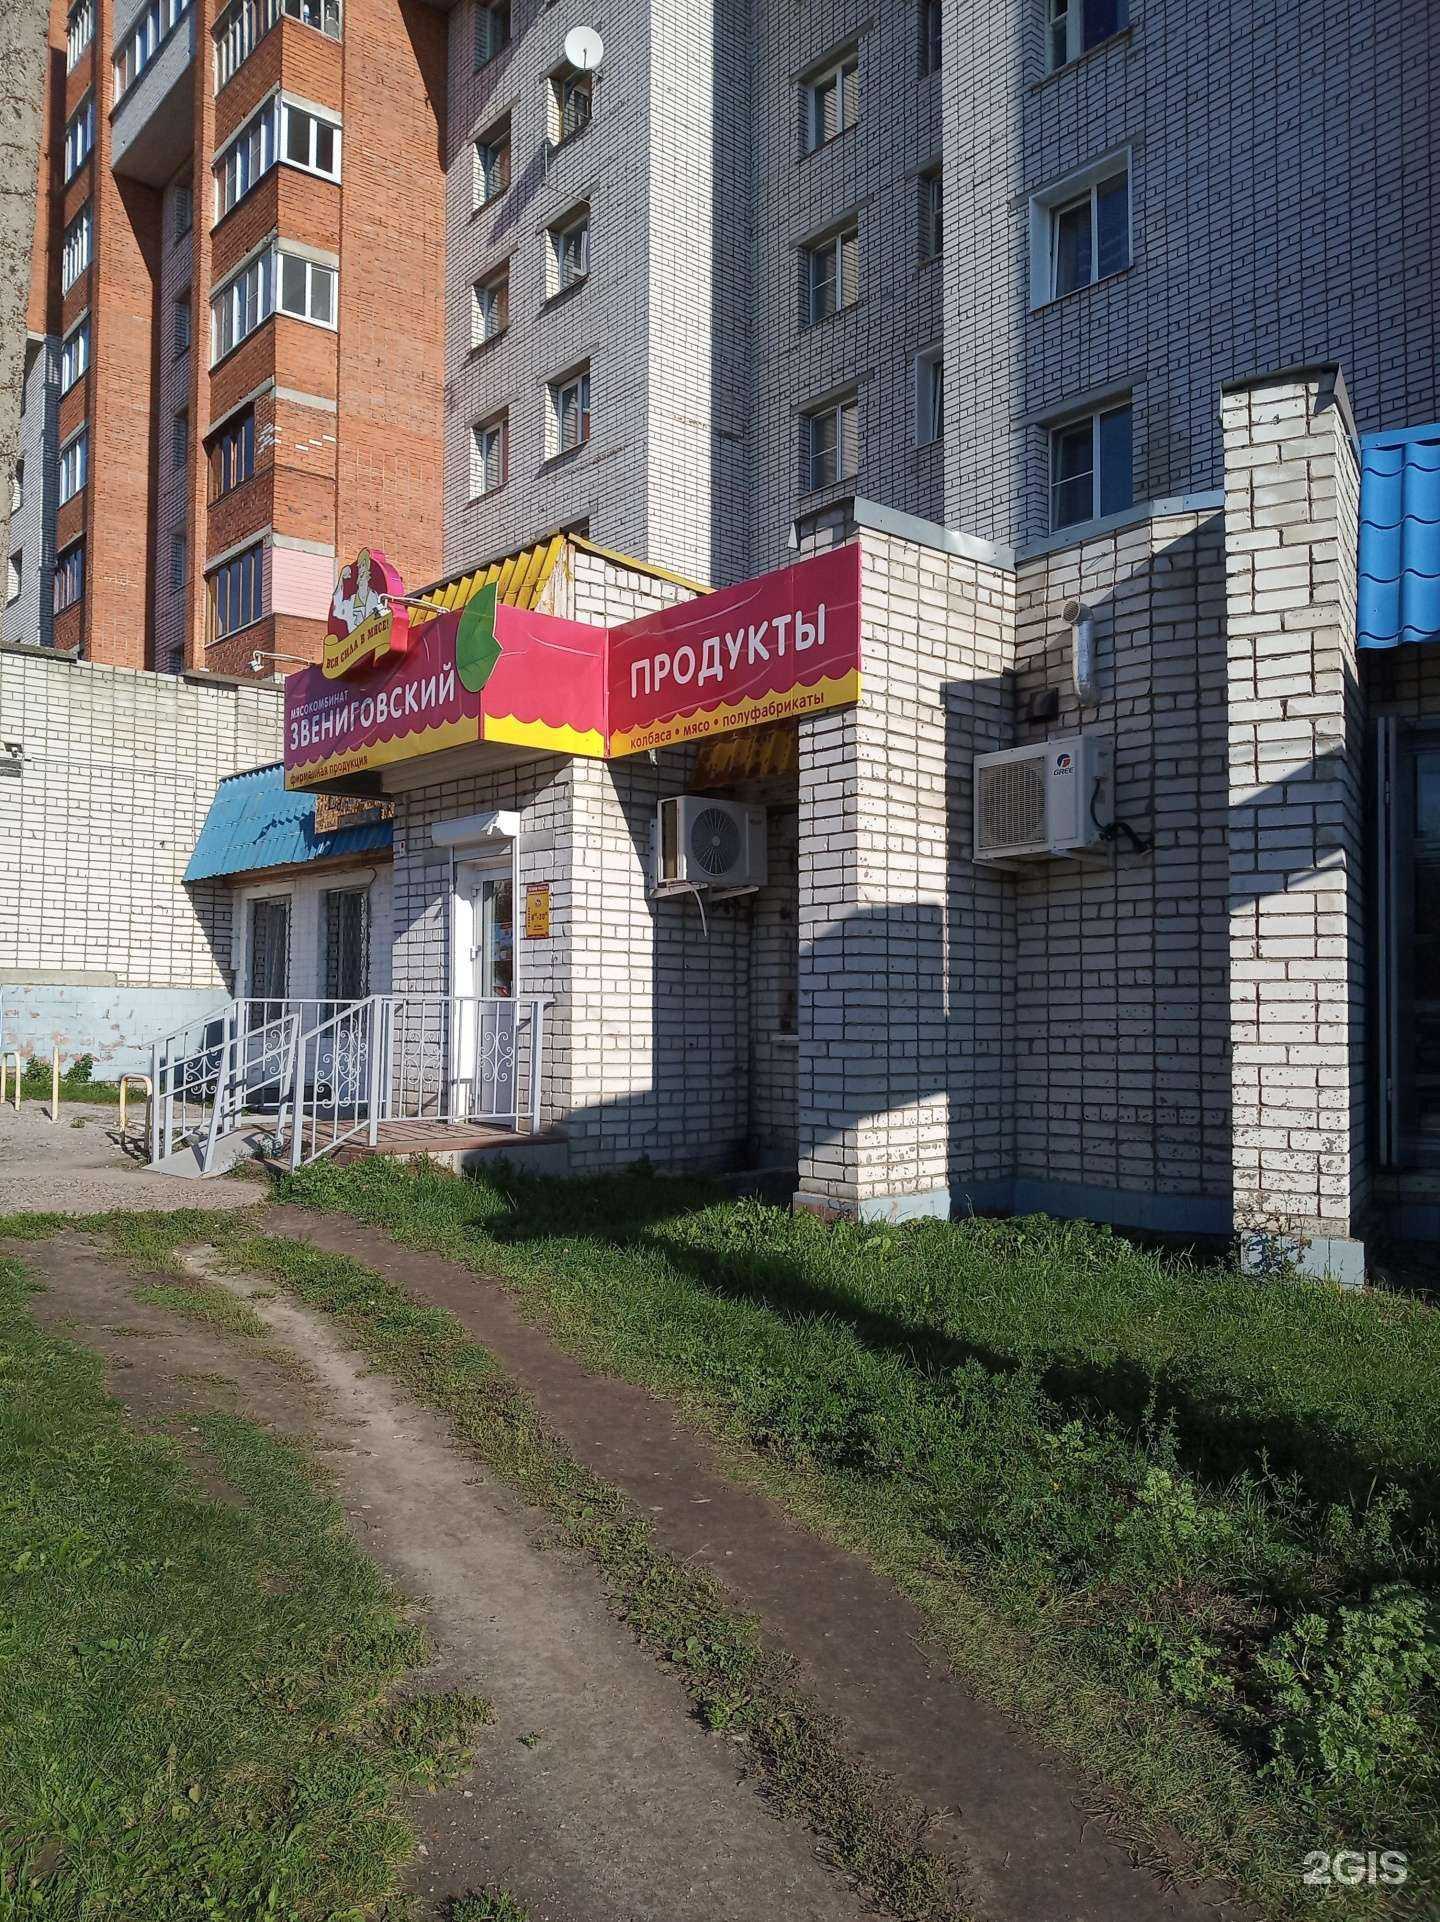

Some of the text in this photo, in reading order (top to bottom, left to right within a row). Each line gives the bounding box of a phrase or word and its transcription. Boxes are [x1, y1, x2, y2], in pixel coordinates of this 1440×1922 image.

[326, 656, 339, 669] ВСЯ
[340, 640, 359, 662] СИЛА
[360, 633, 366, 645] В
[631, 603, 825, 698] ПРОДУКТЫ
[290, 662, 455, 750] ЗВЕНИГОВСКИЙ
[291, 689, 349, 720] МЯСОКОМБИНАТ
[631, 692, 825, 750] колбаса мясо полуфабрикаты
[329, 755, 369, 776] продукция
[1053, 767, 1075, 776] GREE
